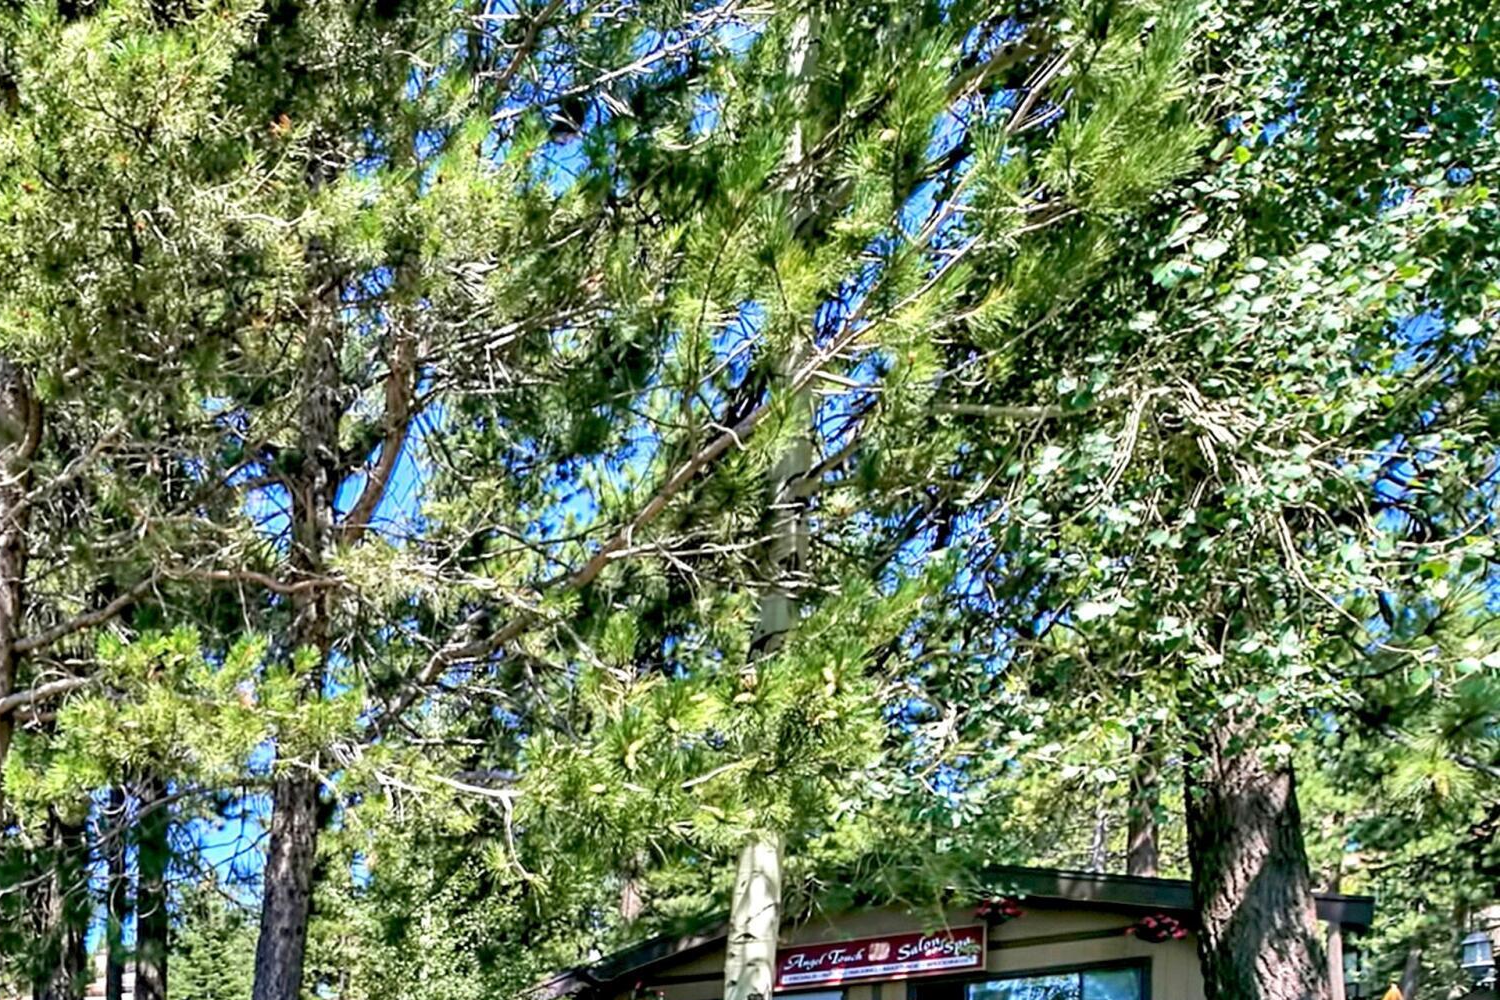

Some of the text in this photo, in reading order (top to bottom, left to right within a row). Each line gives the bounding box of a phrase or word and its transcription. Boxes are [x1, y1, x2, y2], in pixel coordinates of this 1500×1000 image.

[783, 953, 827, 970] Angel
[827, 948, 865, 965] Touch
[897, 936, 940, 960] Salon
